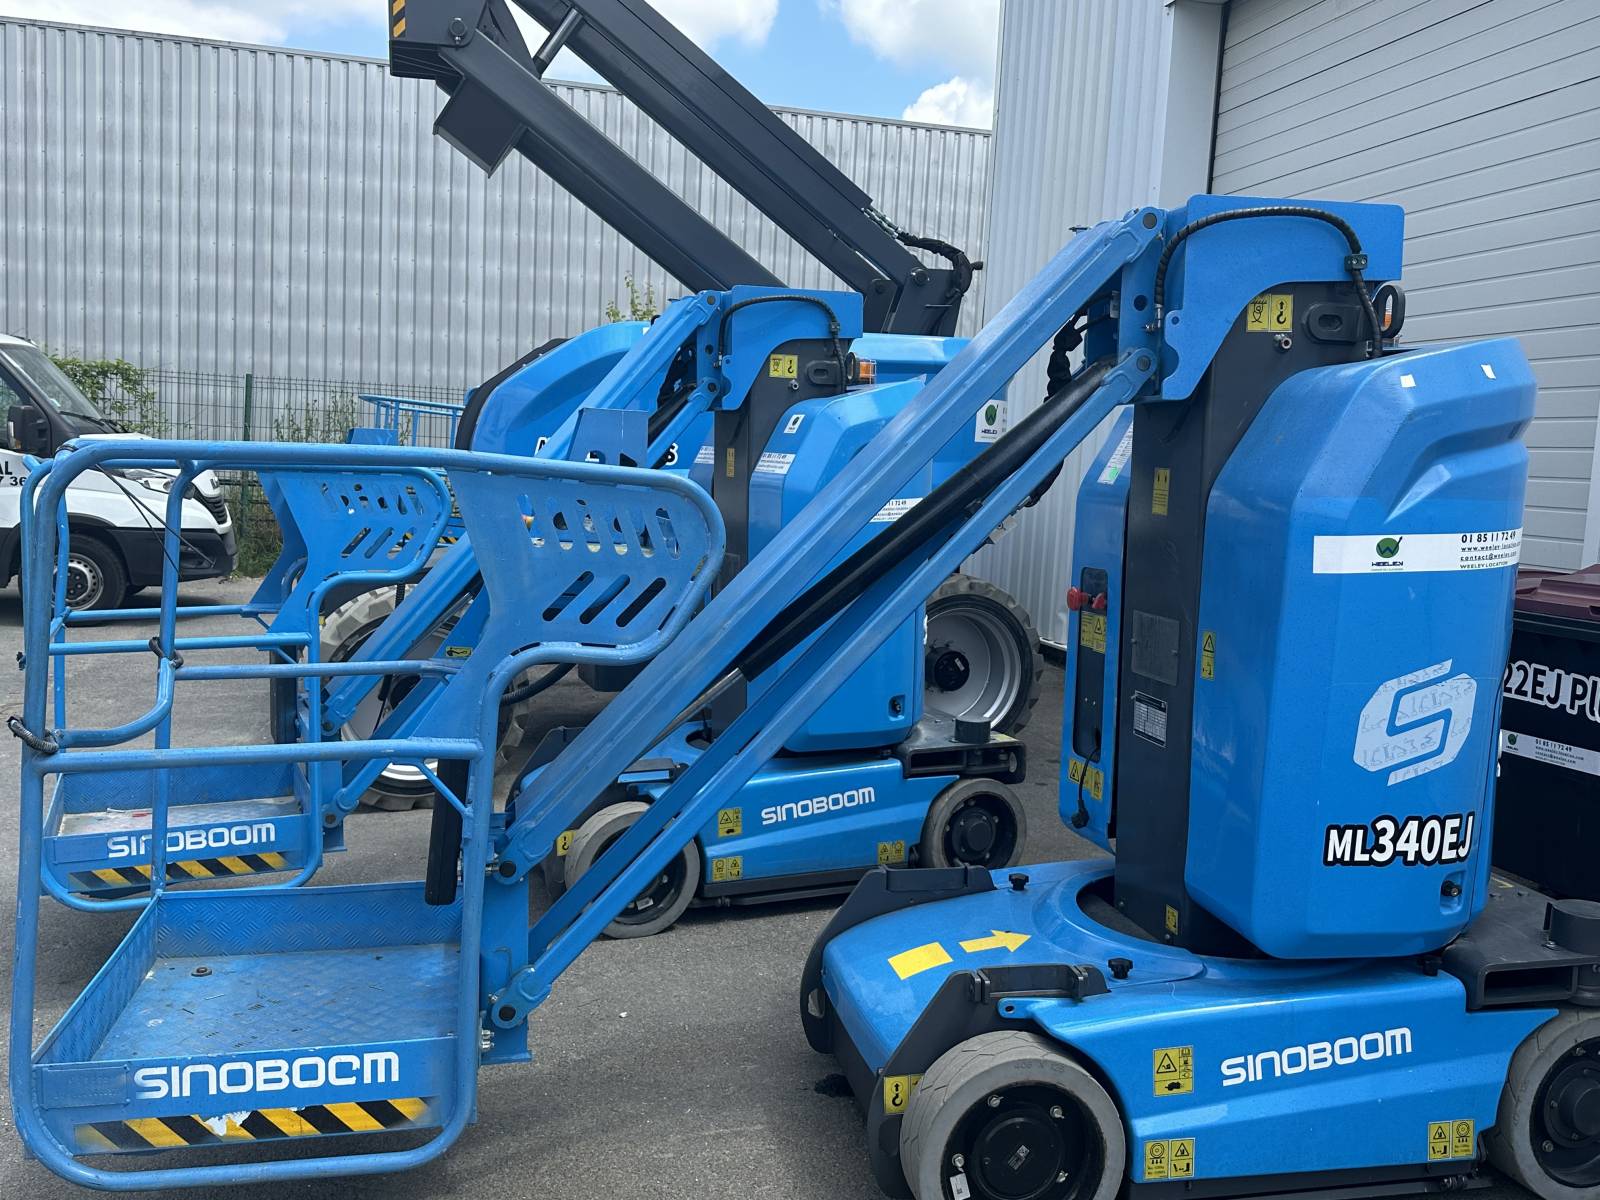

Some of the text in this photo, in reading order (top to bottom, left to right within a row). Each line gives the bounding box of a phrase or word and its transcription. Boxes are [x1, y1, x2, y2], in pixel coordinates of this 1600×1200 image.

[1461, 534, 1473, 543] 01
[1476, 533, 1488, 543] 85
[1491, 532, 1499, 541] 11
[1501, 532, 1509, 540] 72
[761, 787, 875, 825] SINOBOOM
[1326, 814, 1474, 863] ML340EJ
[1220, 1027, 1413, 1087] SINOBOOM
